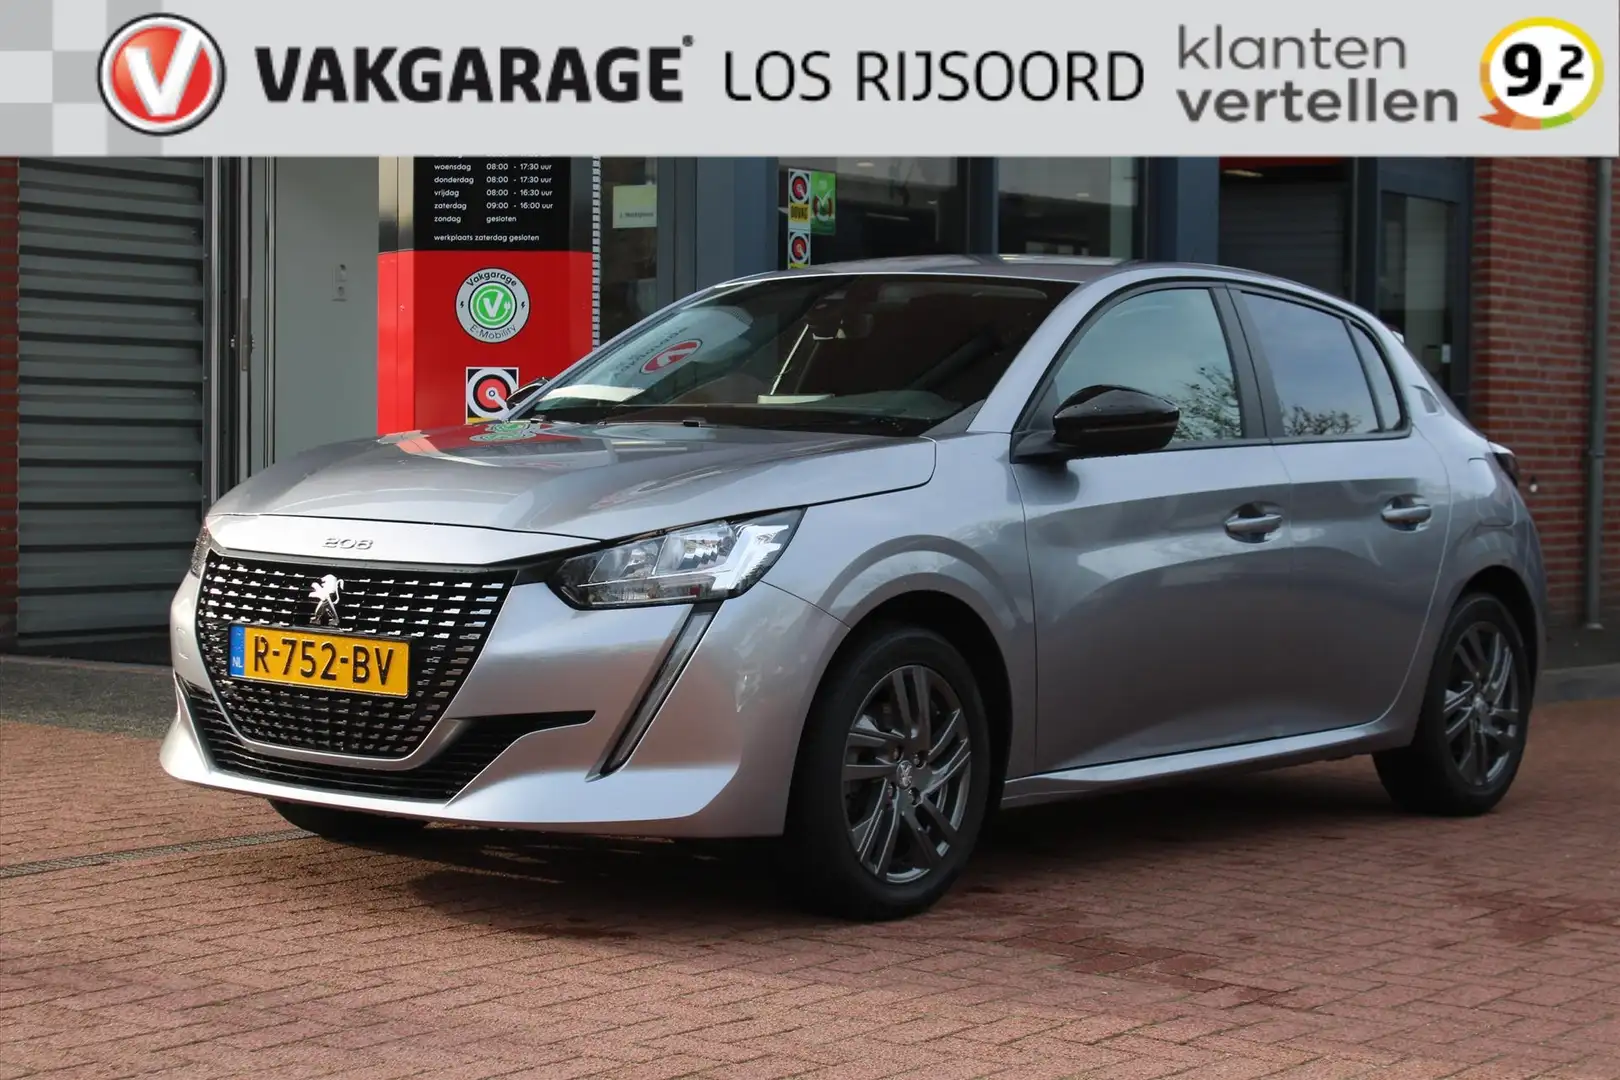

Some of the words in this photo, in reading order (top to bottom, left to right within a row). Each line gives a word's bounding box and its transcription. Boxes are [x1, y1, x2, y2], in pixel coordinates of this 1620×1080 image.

[434, 163, 472, 172] woensdag
[434, 176, 475, 185] donderdag
[434, 189, 460, 198] vrijdag
[434, 202, 467, 211] zaterdag
[434, 215, 462, 224] zondag
[486, 215, 517, 224] gesloten
[434, 233, 473, 243] werkplaats
[474, 233, 508, 243] zaterdag
[508, 234, 540, 243] gesloten
[466, 271, 517, 287] Vakgarage
[469, 324, 516, 339] E-Mobility
[321, 537, 374, 550] 208
[253, 635, 395, 686] R-752-BV
